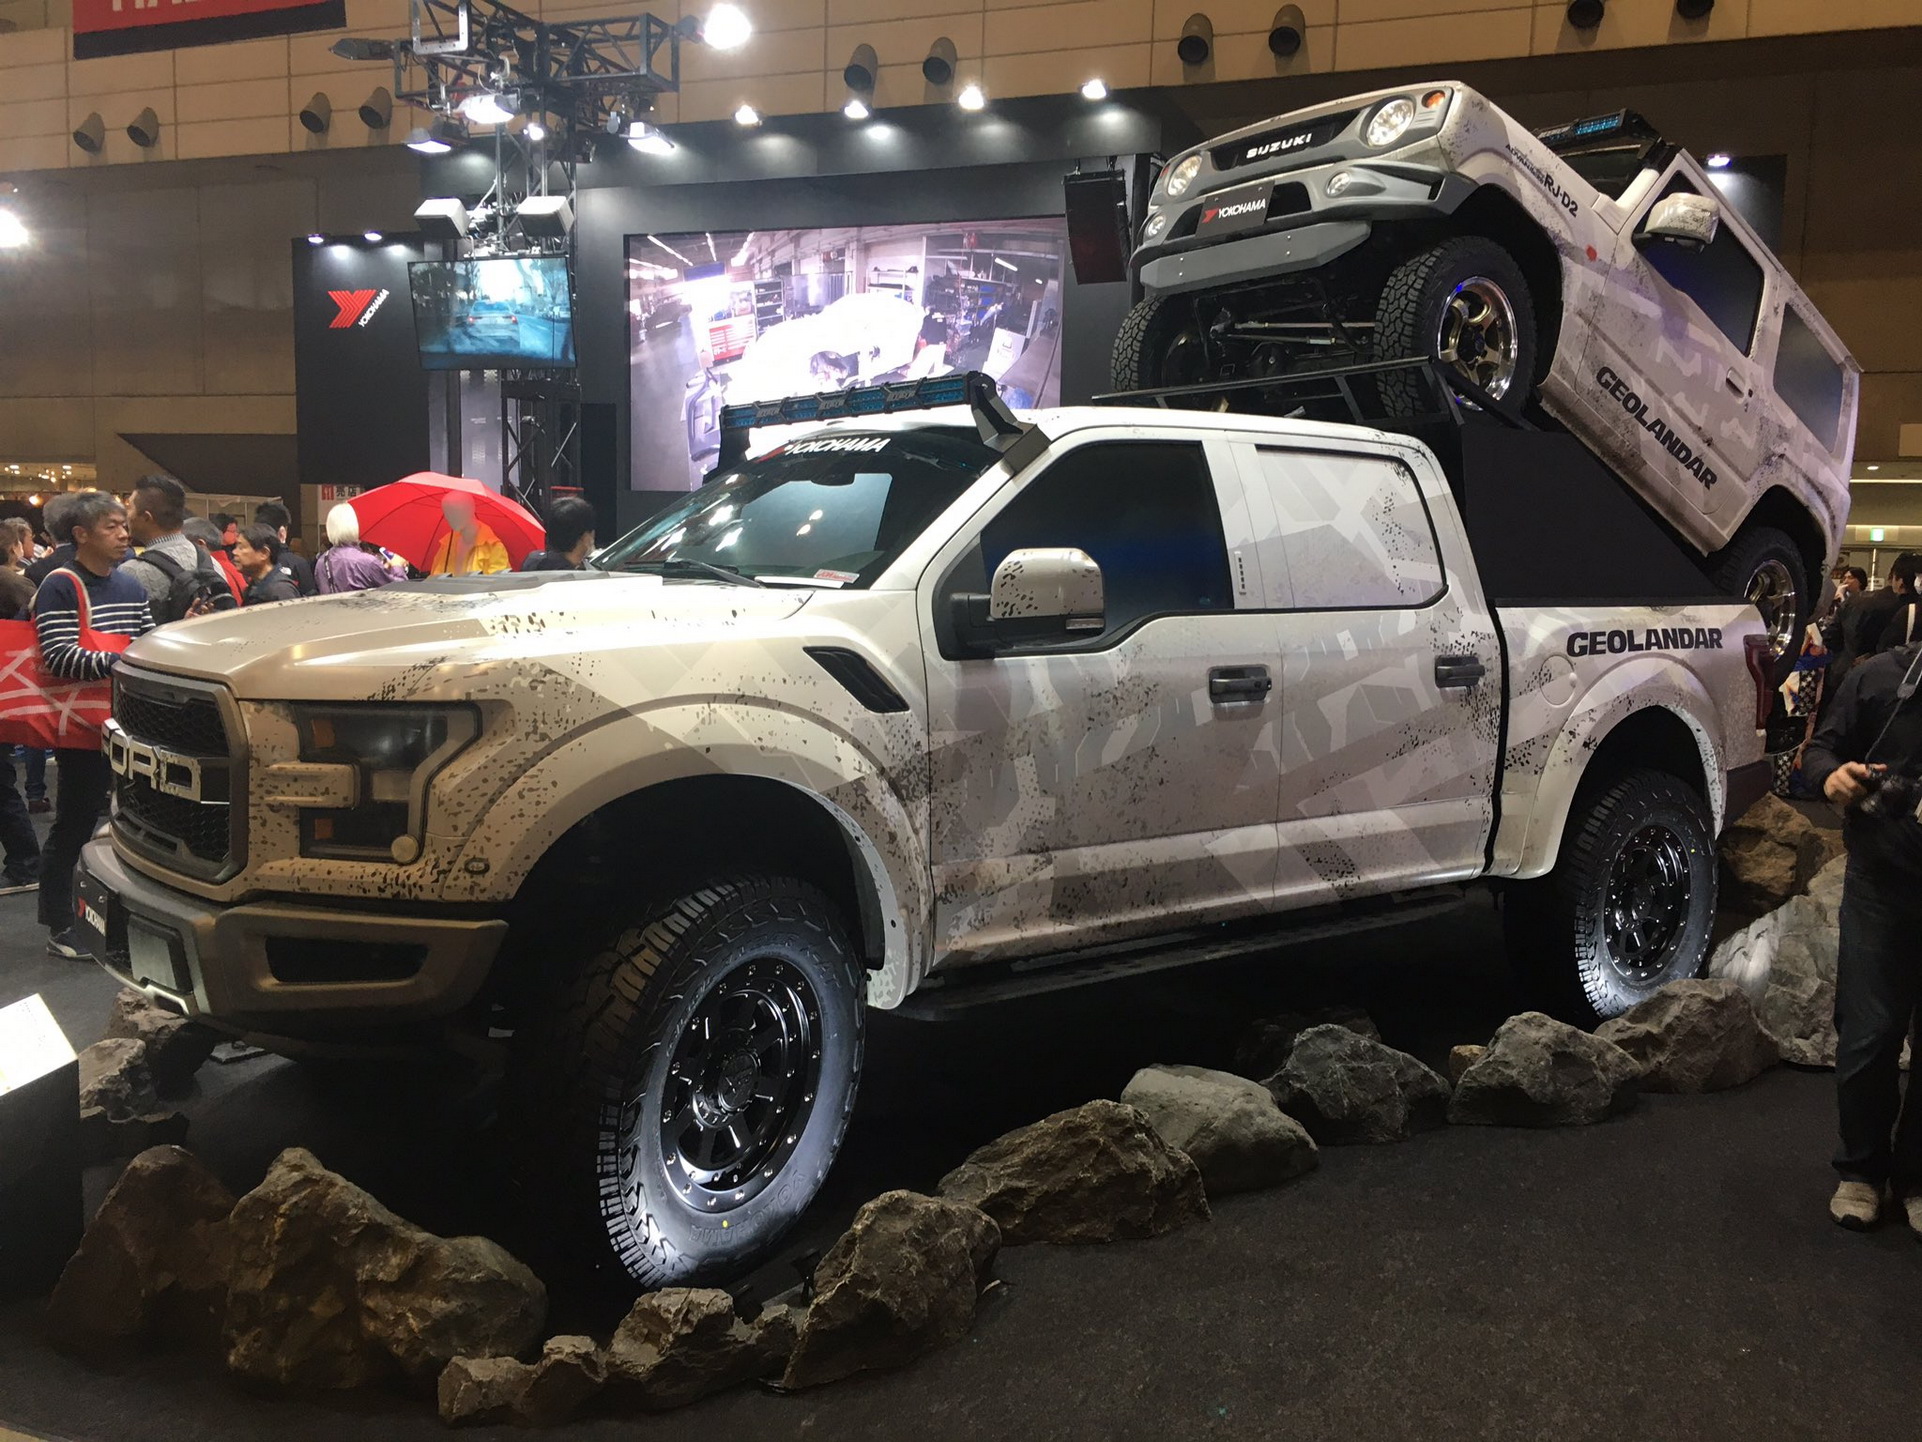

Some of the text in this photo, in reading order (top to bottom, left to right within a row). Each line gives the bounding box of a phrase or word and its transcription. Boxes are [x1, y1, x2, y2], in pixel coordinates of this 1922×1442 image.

[1246, 133, 1312, 158] SUZUKI
[1218, 198, 1266, 218] YOKOHAMA
[358, 288, 389, 327] YOKOHAMA
[1596, 366, 1718, 490] GEOLANDAR
[784, 438, 891, 457] YOKOHAMA
[1566, 628, 1723, 657] GEOLANDAR
